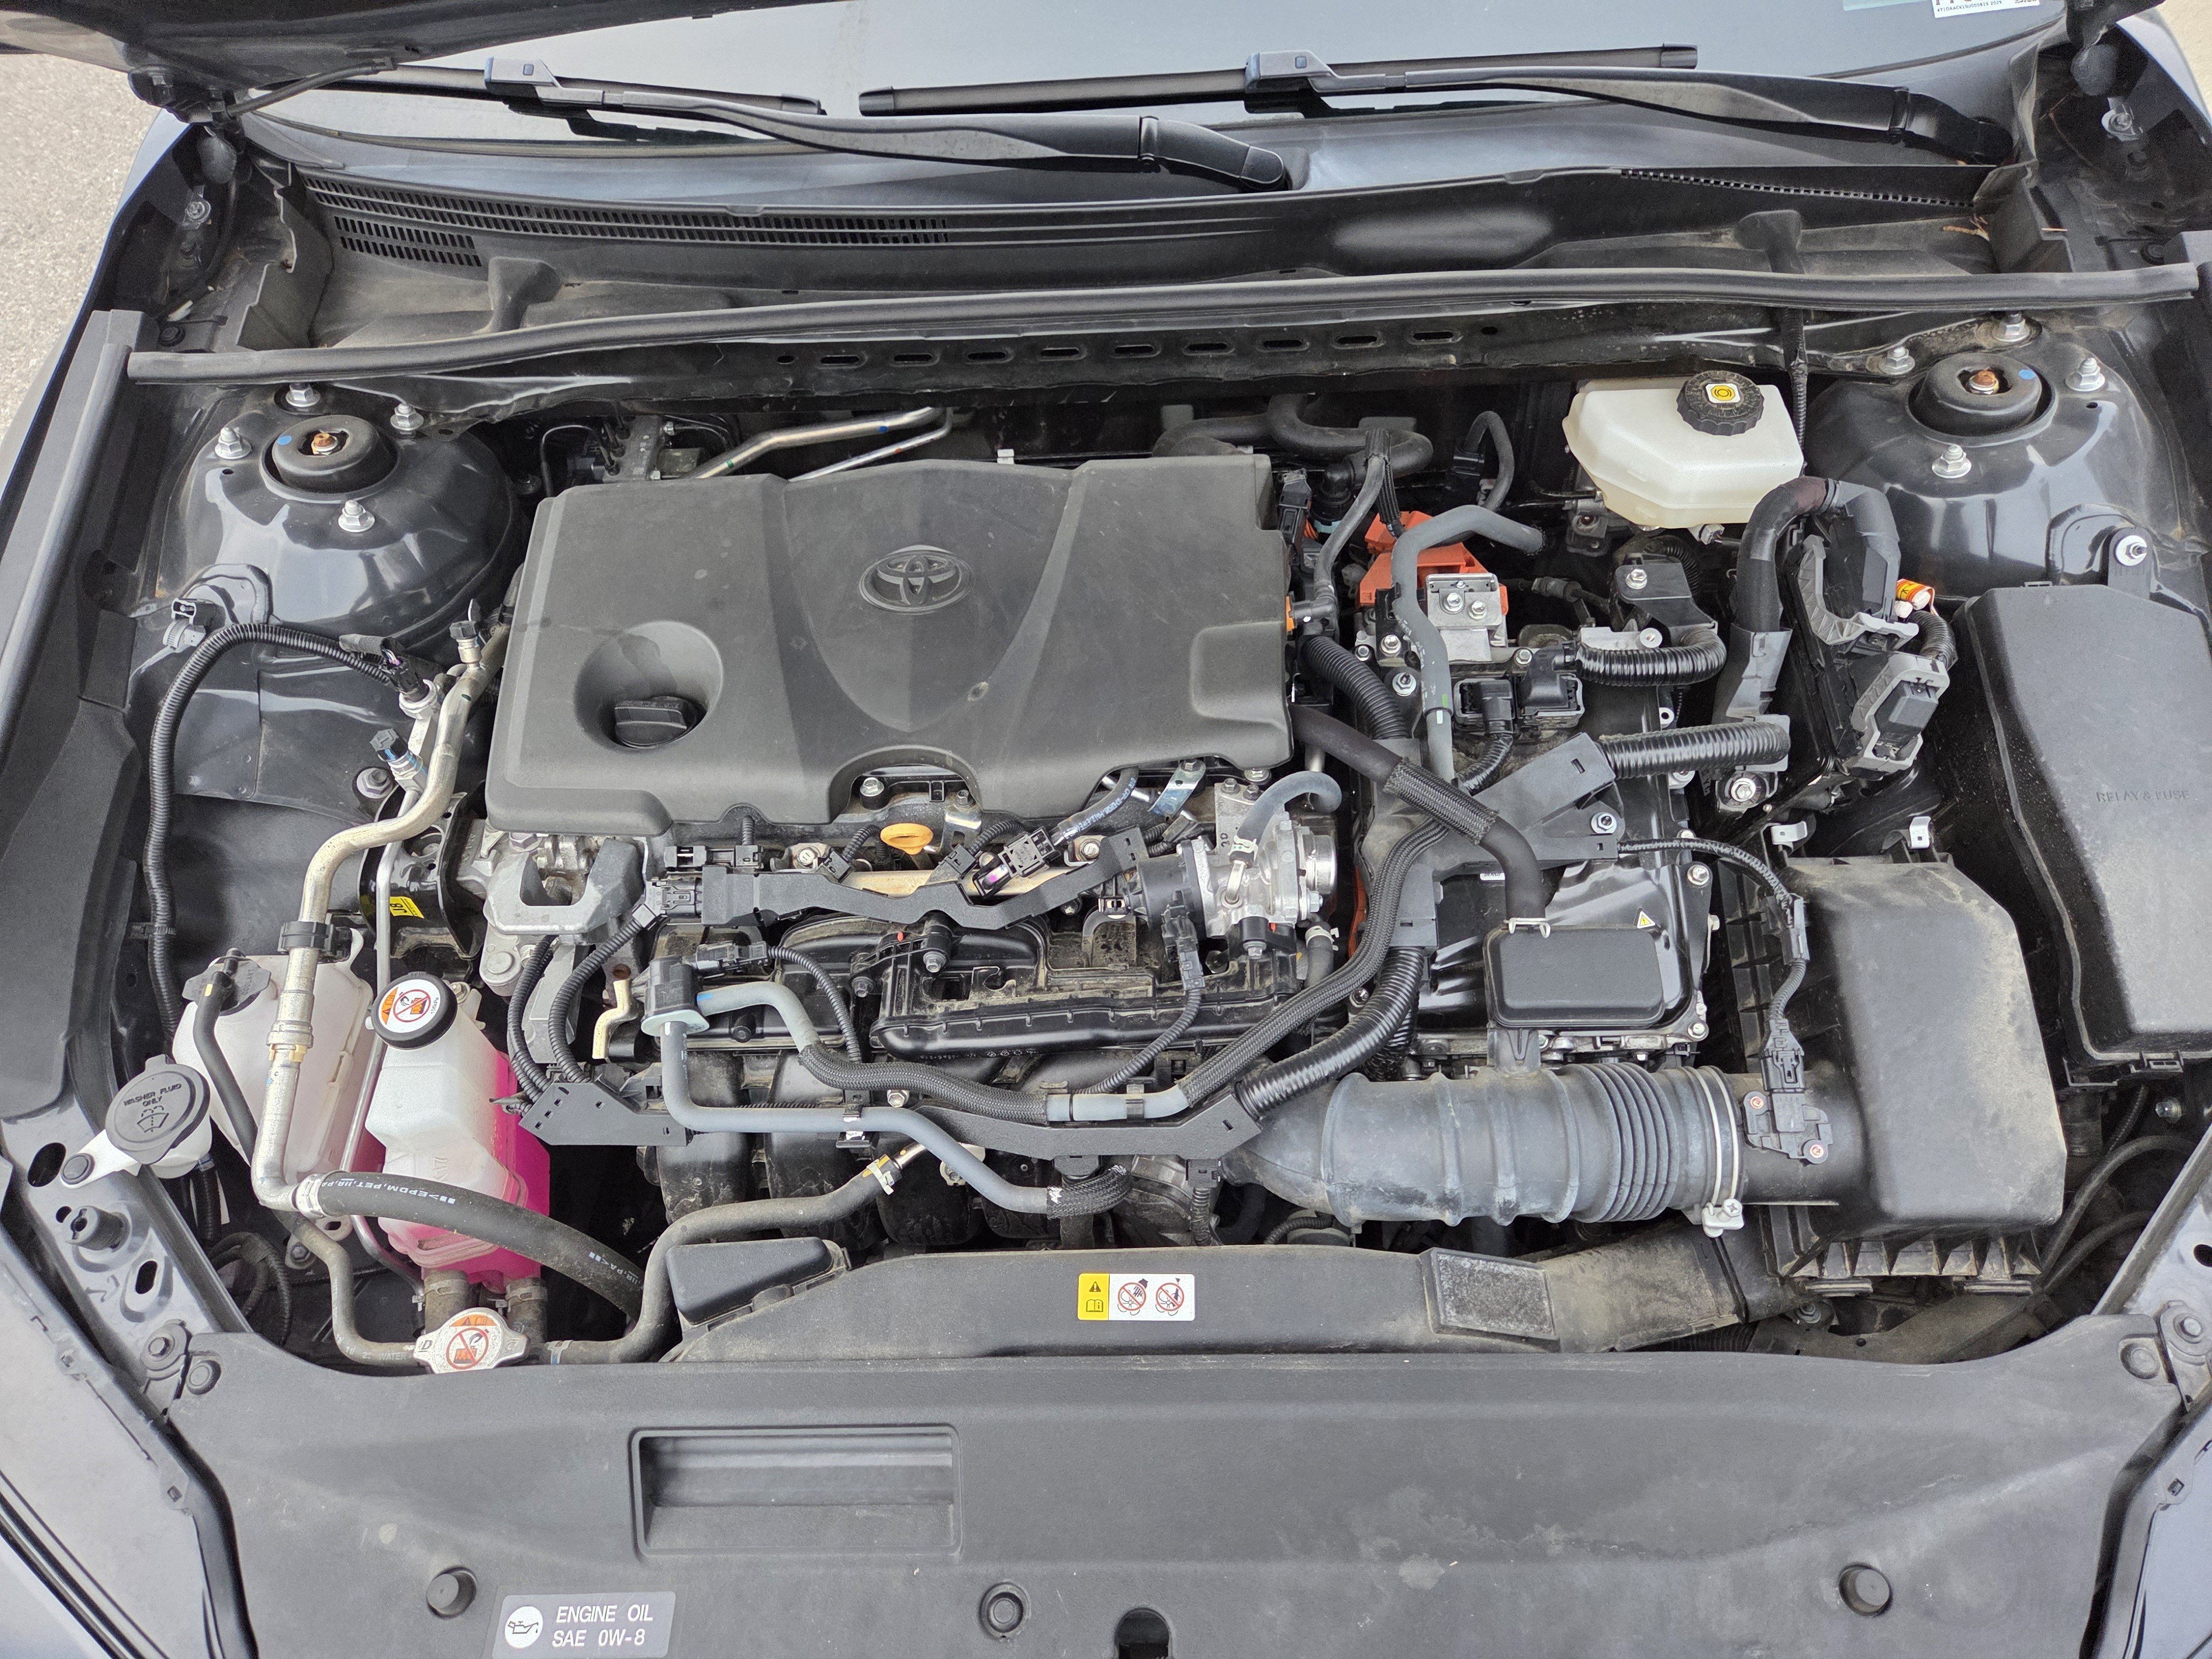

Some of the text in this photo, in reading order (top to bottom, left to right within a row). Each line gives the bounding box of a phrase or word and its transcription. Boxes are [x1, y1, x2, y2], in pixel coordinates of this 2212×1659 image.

[2096, 790, 2190, 802] RELAY & FUSE
[123, 1083, 182, 1106] WASHER FLUID
[142, 1095, 163, 1107] ONLY
[379, 1352, 406, 1360] WATER
[556, 1604, 654, 1623] ENGINE OIL
[552, 1628, 646, 1647] SAE 0W-8
